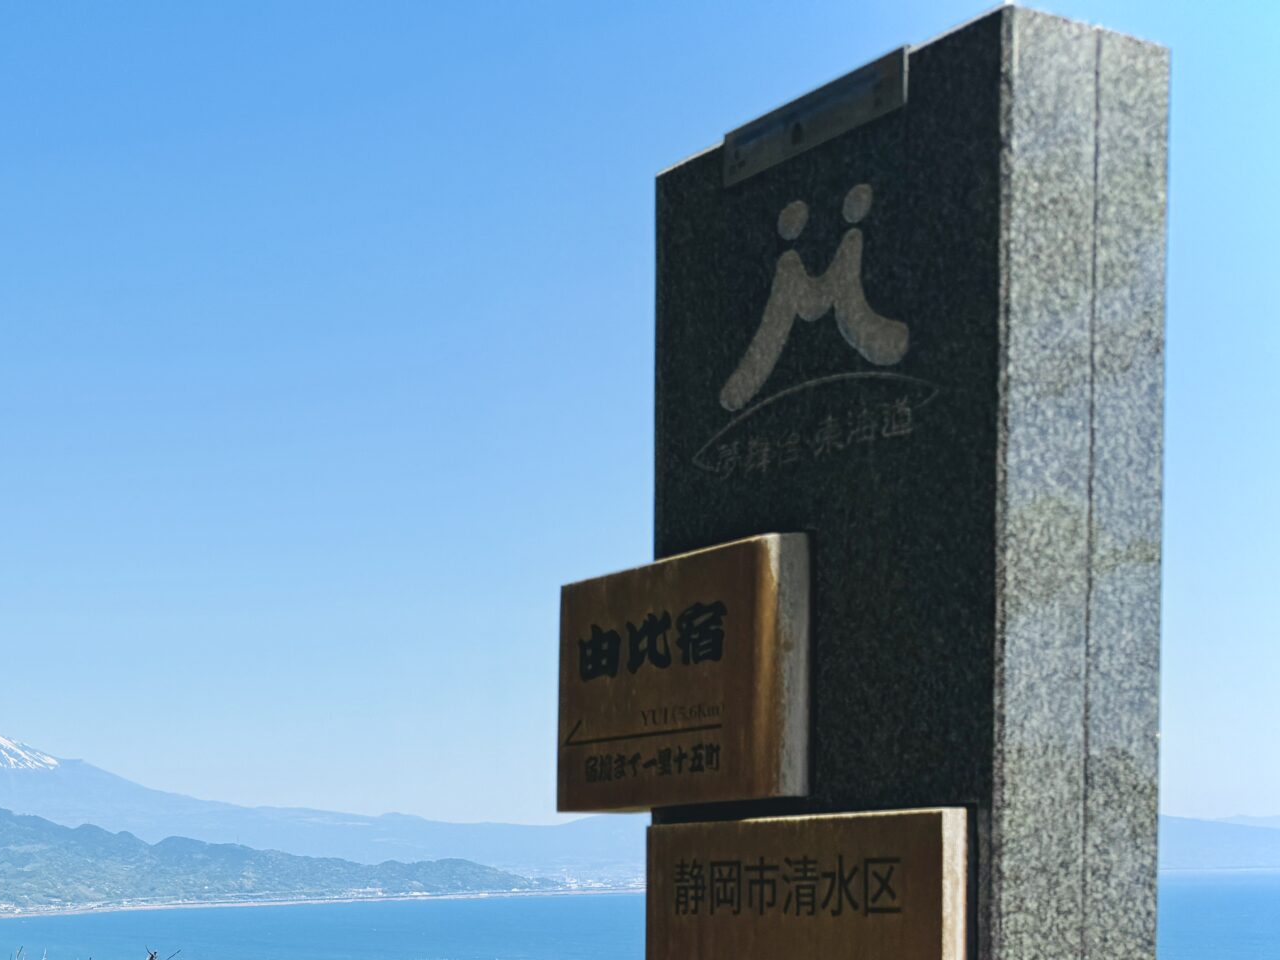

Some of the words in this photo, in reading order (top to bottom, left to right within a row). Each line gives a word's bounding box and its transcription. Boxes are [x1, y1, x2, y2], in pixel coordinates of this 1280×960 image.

[578, 601, 728, 682] 由比宿
[640, 706, 668, 726] YUI
[673, 854, 903, 917] 静岡市清水区
